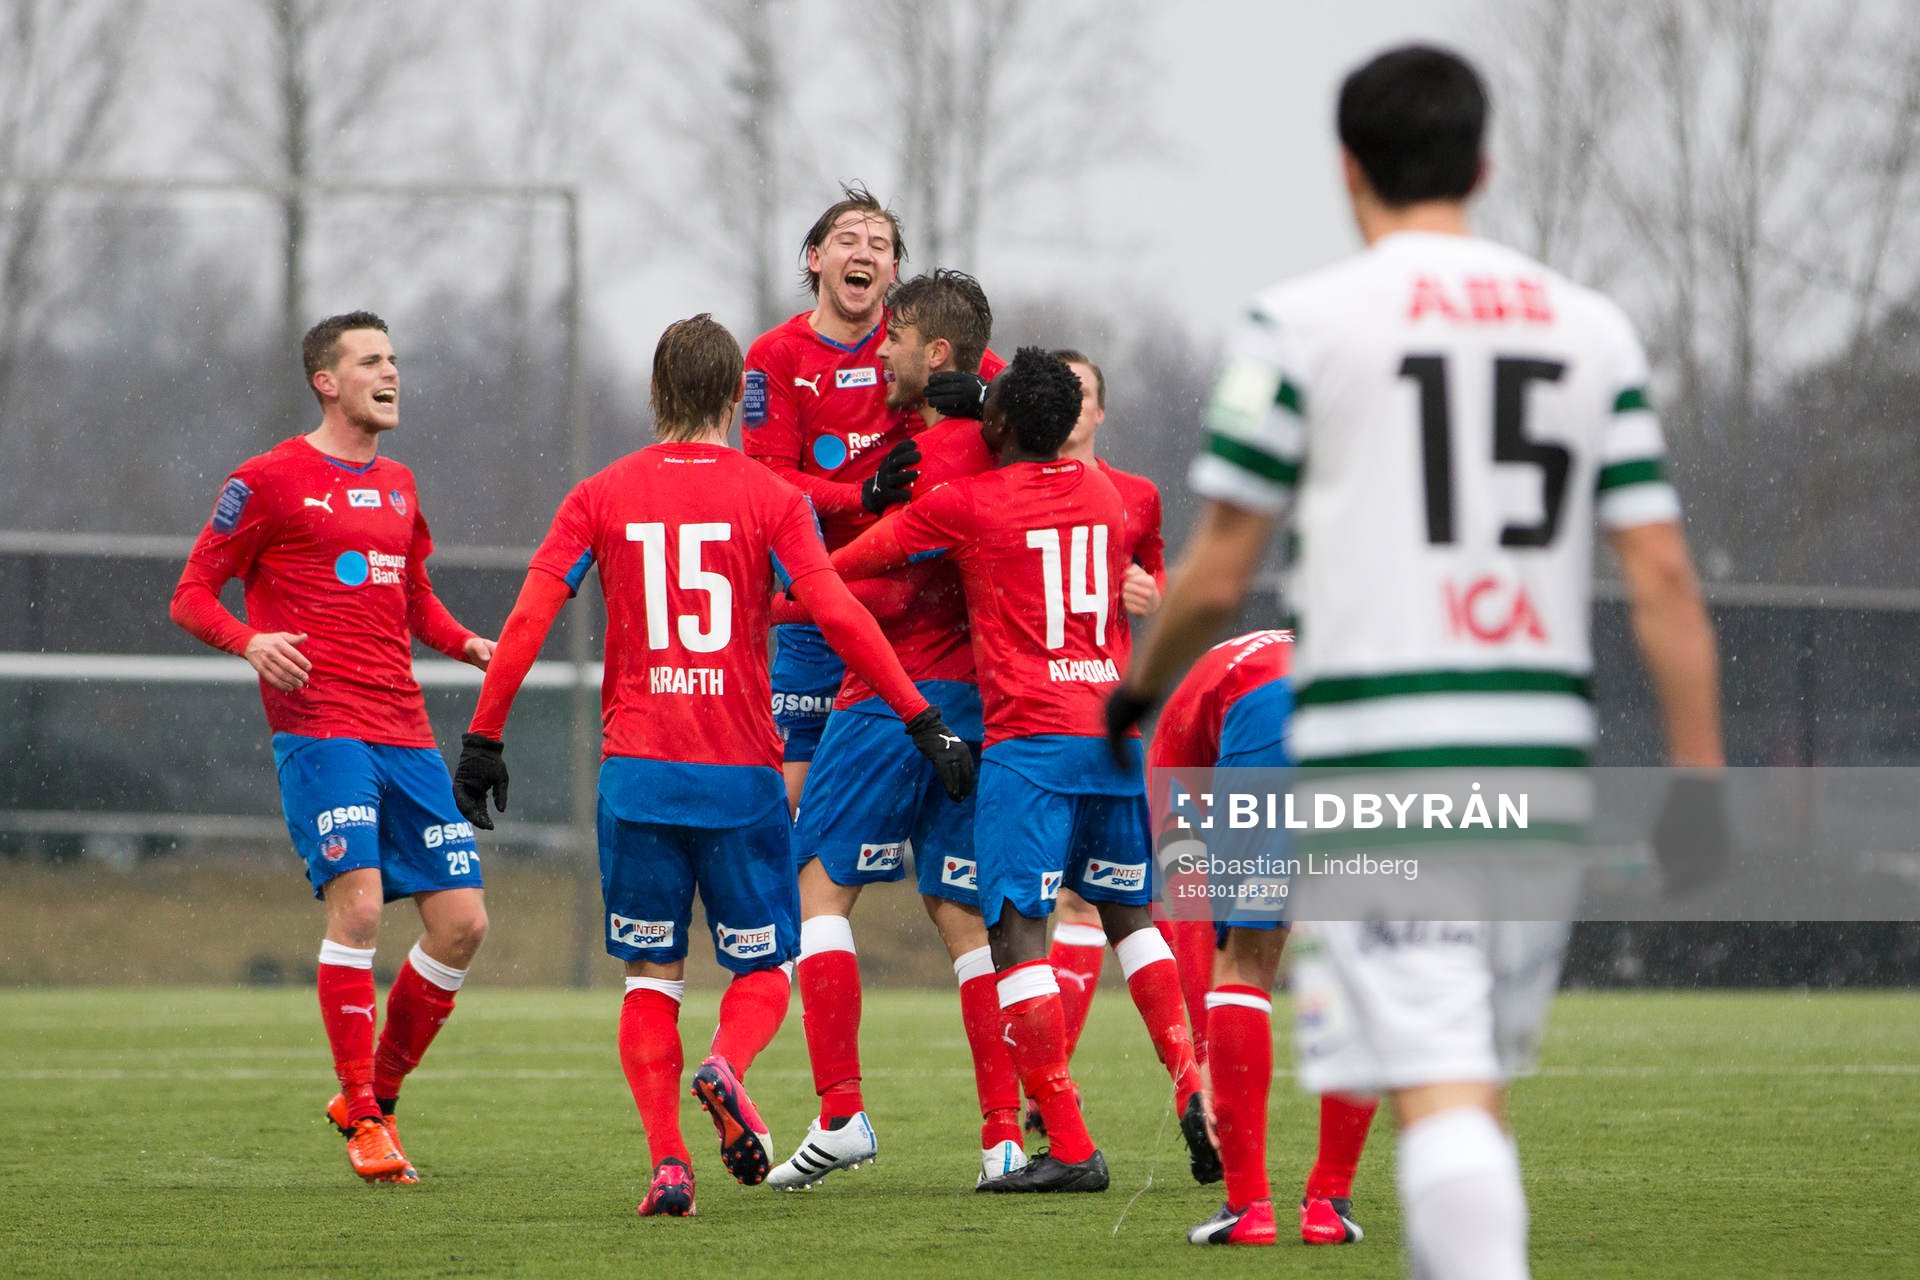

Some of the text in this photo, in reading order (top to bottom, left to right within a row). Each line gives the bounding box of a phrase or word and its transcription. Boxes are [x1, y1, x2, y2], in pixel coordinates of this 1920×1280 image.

[1398, 352, 1574, 549] 15
[371, 567, 401, 584] Bank
[625, 522, 733, 653] 15
[1026, 524, 1108, 649] 14
[1440, 573, 1550, 645] ICA
[1048, 657, 1121, 683] ATAKORA
[650, 666, 724, 696] KRAFTH
[784, 693, 837, 713] SOLI
[446, 850, 471, 876] 29
[1112, 868, 1142, 878] INTER
[1111, 878, 1140, 887] SPORT
[633, 923, 666, 936] INTER
[633, 935, 666, 944] SPORT
[736, 931, 770, 943] INTER
[737, 942, 769, 954] SPORT
